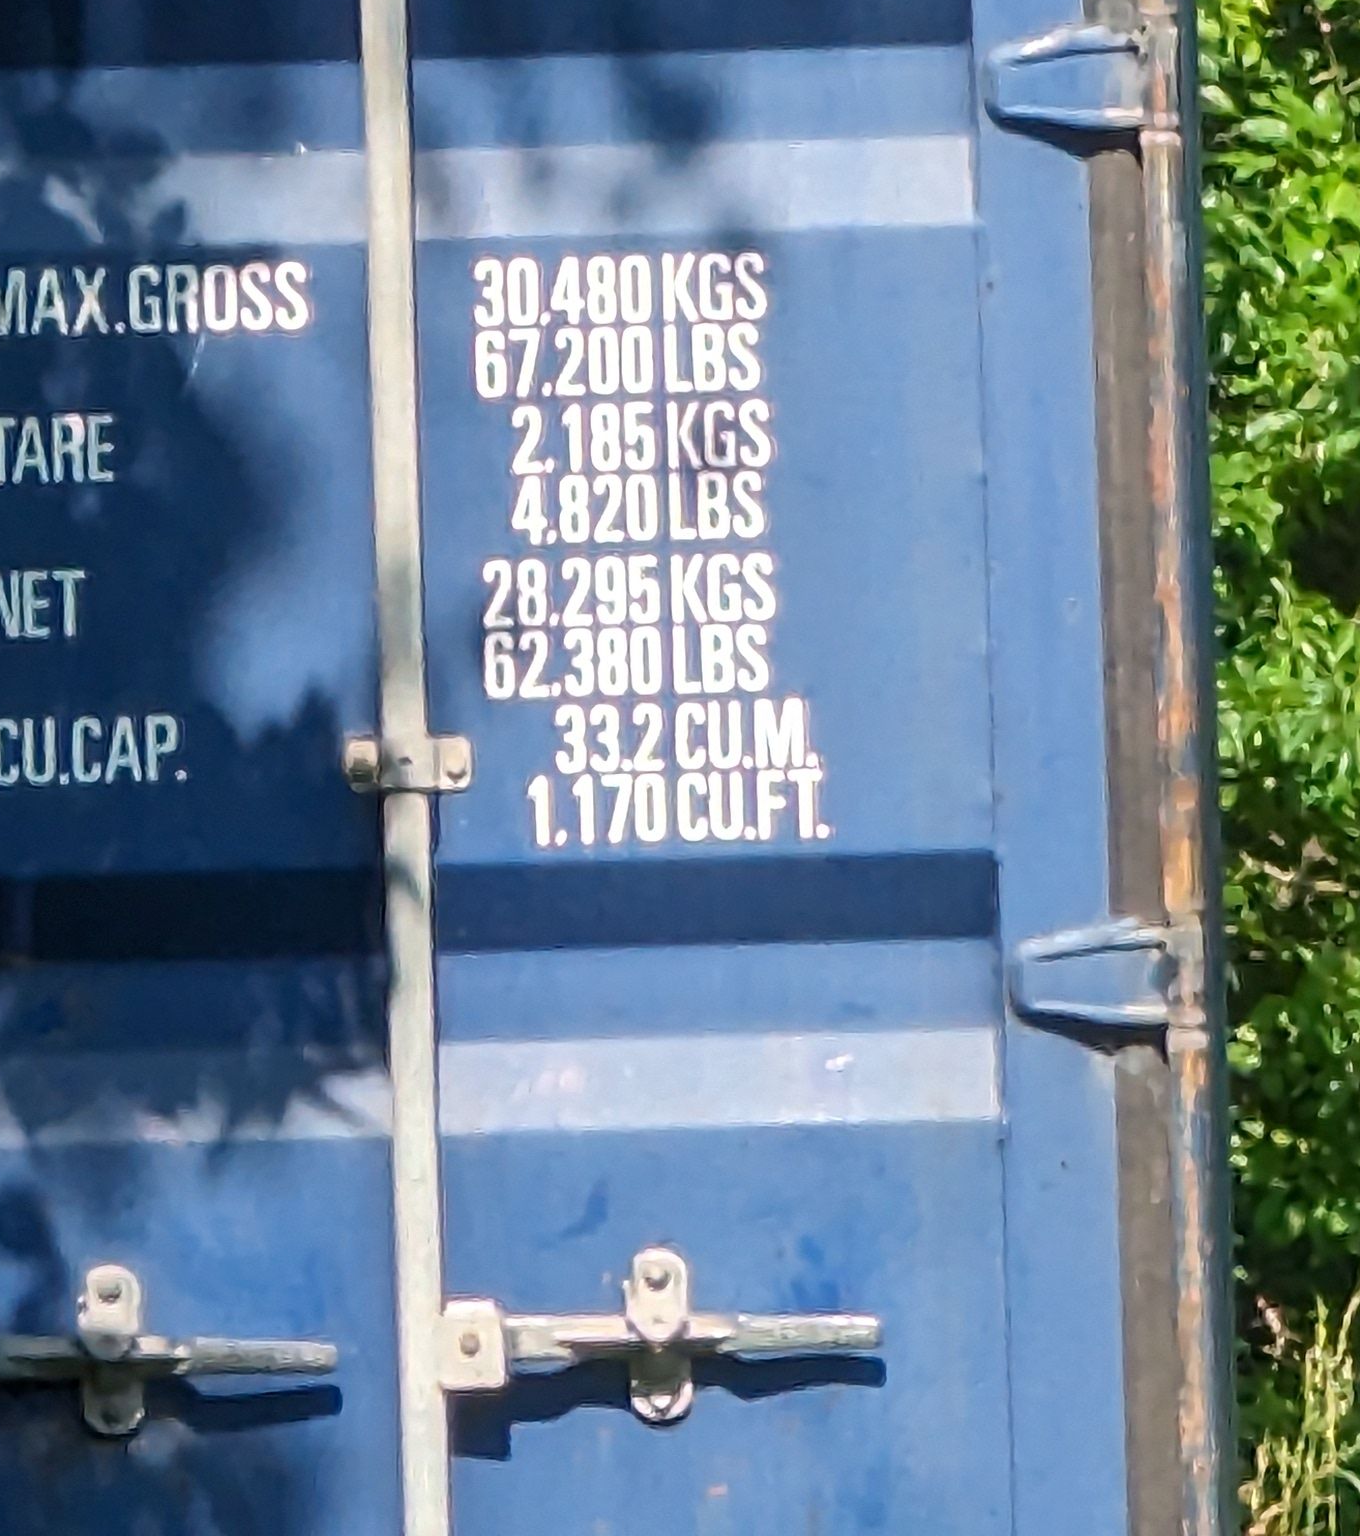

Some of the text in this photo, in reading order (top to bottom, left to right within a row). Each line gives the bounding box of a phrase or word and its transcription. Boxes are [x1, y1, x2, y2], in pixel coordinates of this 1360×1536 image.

[472, 253, 654, 328] 30.480
[660, 251, 769, 323] KGS
[473, 321, 762, 399] 67.200 LBS
[510, 399, 657, 476] 2.185
[665, 397, 773, 471] KGS
[510, 469, 769, 546] 4.820 LBS
[481, 552, 662, 629] 28.295
[669, 551, 778, 625] KGS
[483, 622, 771, 700] 62.380 LBS
[553, 701, 667, 775] 33.2
[673, 696, 822, 772] CU.M.
[526, 767, 832, 848] 1.170 CU.FT.
